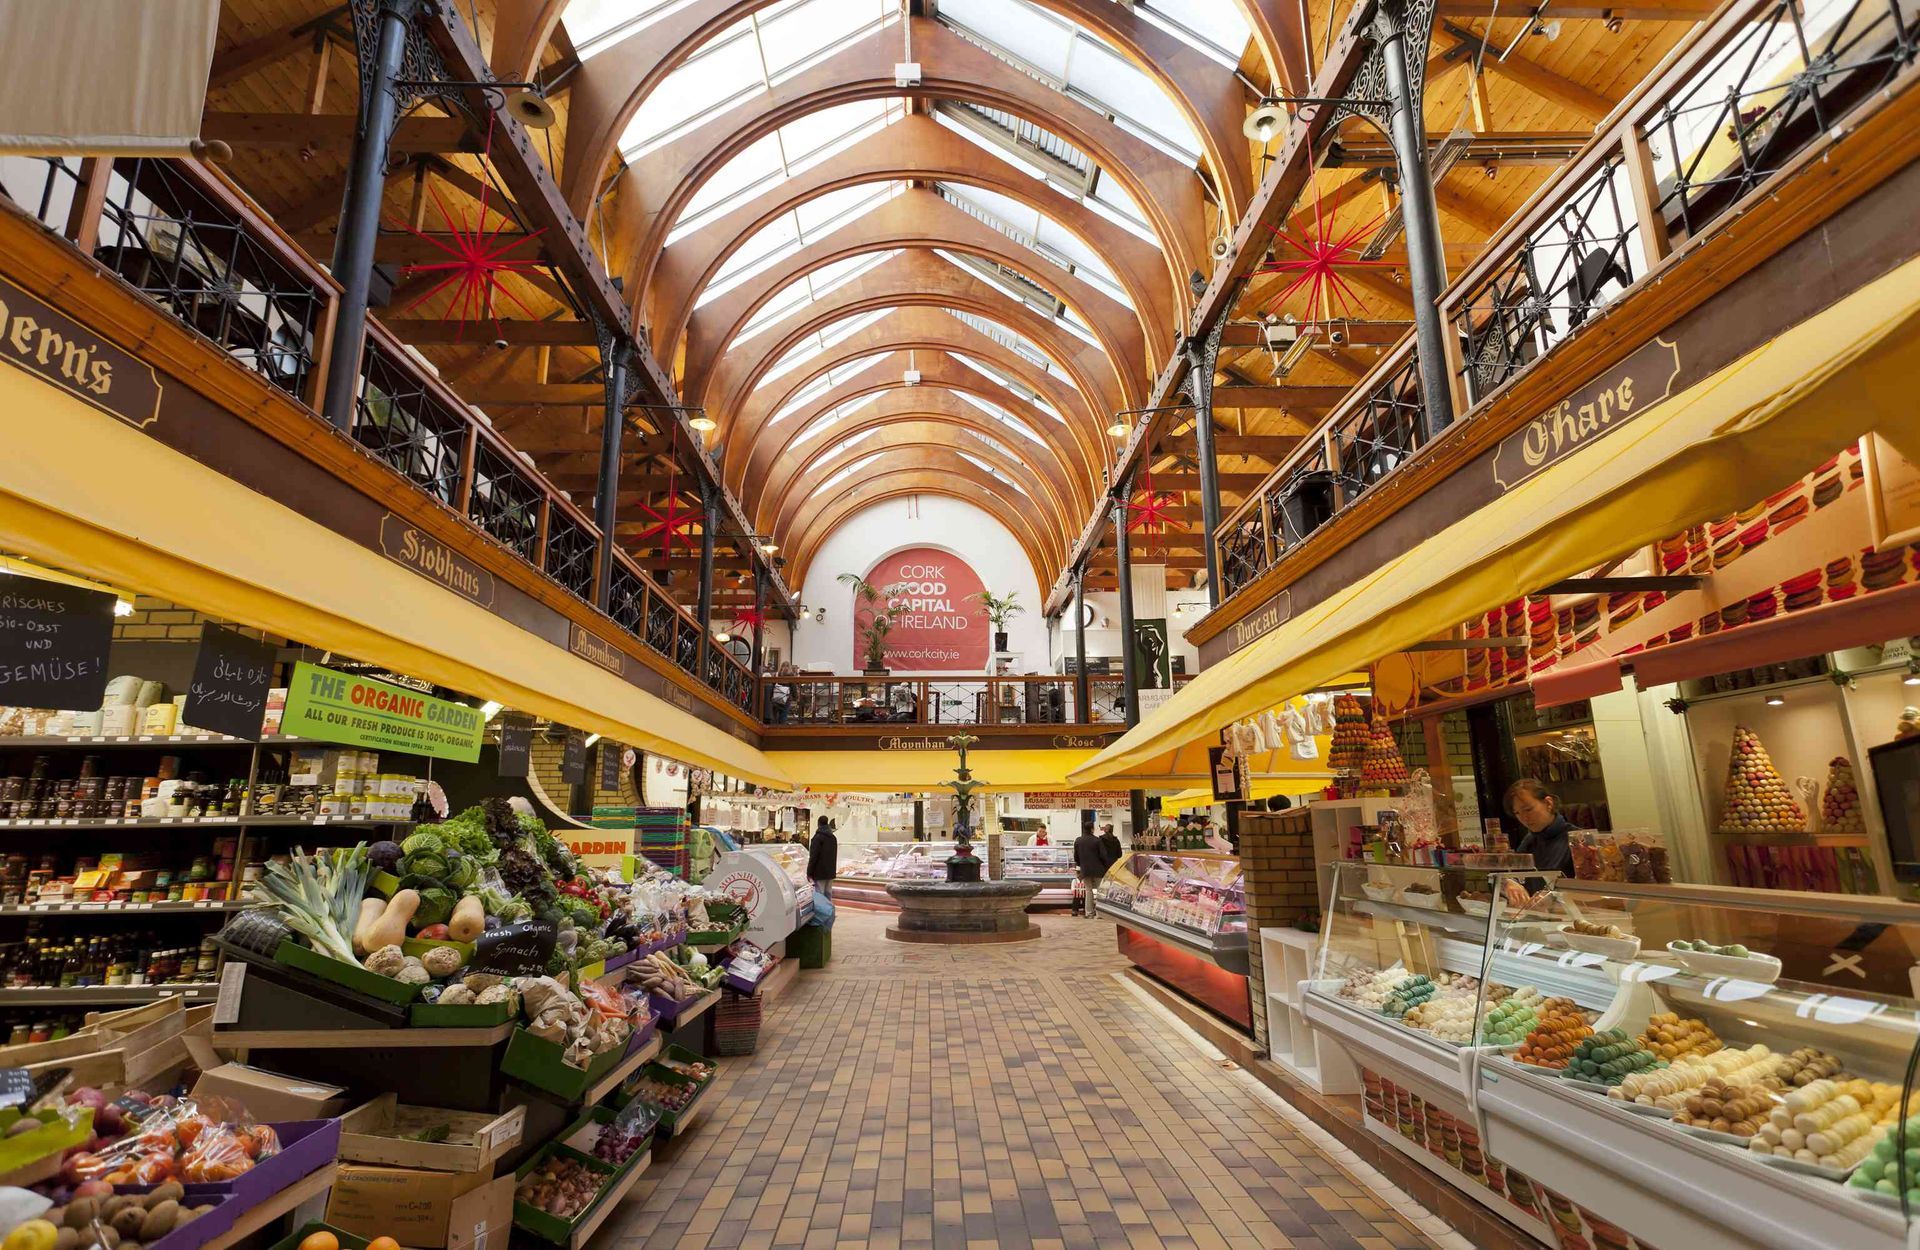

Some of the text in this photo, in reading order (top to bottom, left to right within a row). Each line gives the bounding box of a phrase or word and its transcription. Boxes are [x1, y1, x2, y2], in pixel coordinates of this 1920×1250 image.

[900, 565, 945, 579] CORK
[888, 598, 955, 612] CAPITAL
[901, 615, 968, 630] IRELAND
[25, 639, 53, 650] UND
[883, 647, 960, 662] www.corkcity.ie
[310, 673, 478, 731] THE ORGANIC GARDEN
[304, 707, 475, 748] ALL OUR FRESH PRODUCE IS 100% ORGANIC
[360, 734, 392, 745] CERTIFICATION
[889, 737, 945, 749] Moynihan
[1062, 735, 1094, 748] Rose
[844, 794, 874, 804] OULTRY
[565, 842, 626, 855] ARDEN
[494, 942, 539, 958] Spinach
